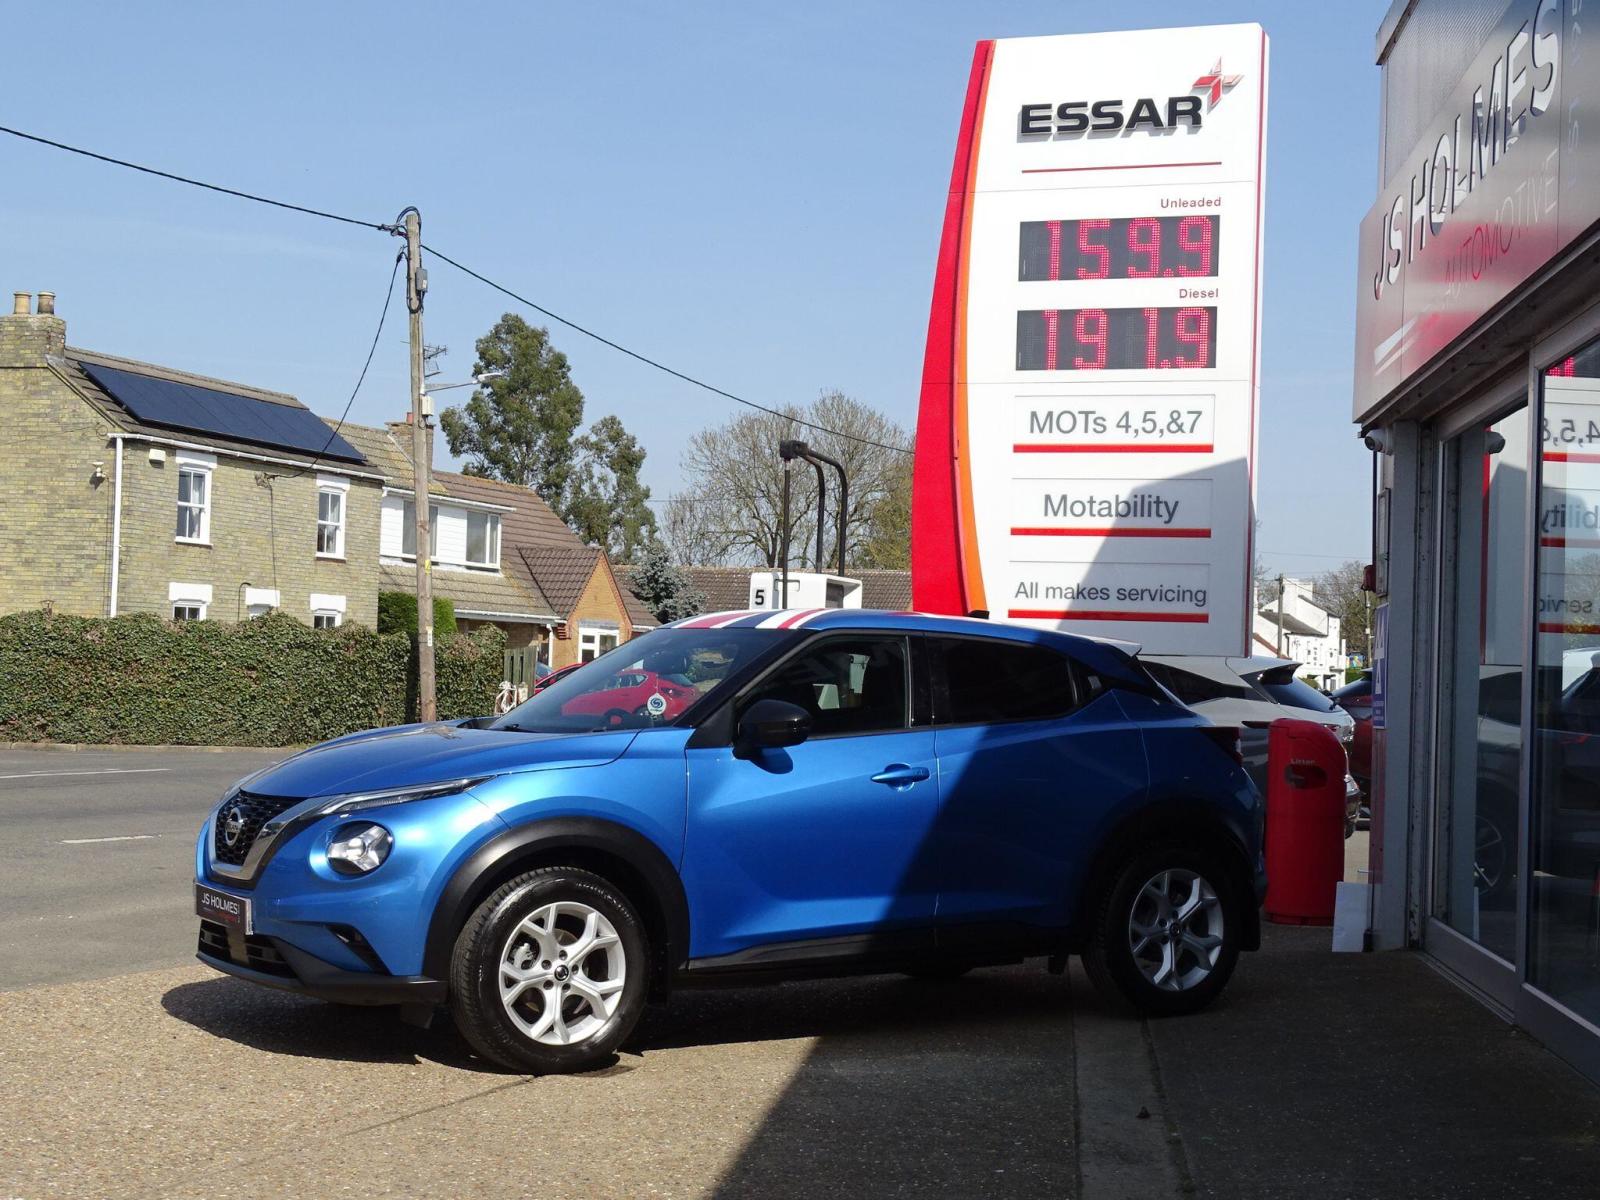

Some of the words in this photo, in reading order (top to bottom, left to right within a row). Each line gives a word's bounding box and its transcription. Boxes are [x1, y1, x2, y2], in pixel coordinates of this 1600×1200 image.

[1019, 95, 1203, 138] ESSAR
[1374, 195, 1403, 300] JS
[1408, 0, 1558, 264] HOLMES
[1160, 196, 1222, 209] Unleaded
[1046, 215, 1212, 281] 159.9
[1179, 288, 1220, 300] Diesel
[1041, 305, 1210, 371] 191.9
[1029, 410, 1108, 435] MOTs
[1115, 410, 1204, 438] 4,5,&7
[1043, 494, 1180, 524] Motability
[755, 589, 765, 605] 5
[1014, 582, 1040, 600] All
[1045, 582, 1111, 601] makes
[1115, 585, 1208, 607] servicing
[201, 892, 210, 905] JS
[210, 895, 238, 915] HOLMES
